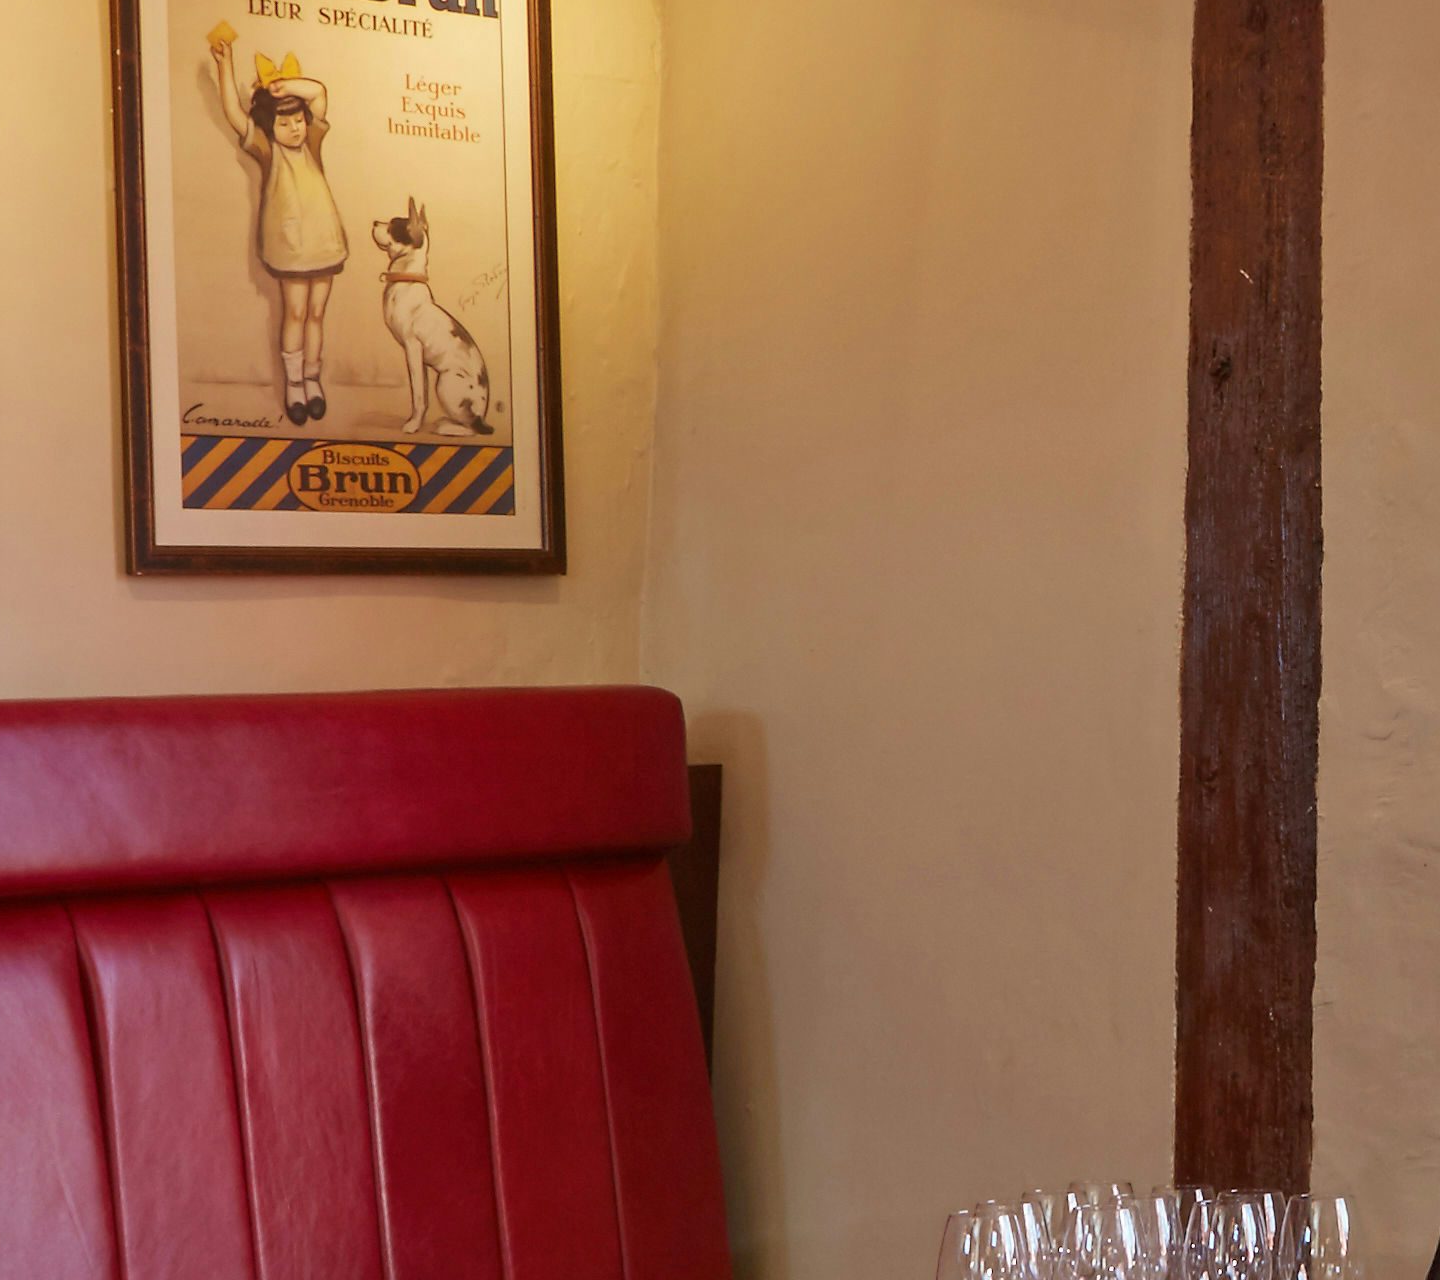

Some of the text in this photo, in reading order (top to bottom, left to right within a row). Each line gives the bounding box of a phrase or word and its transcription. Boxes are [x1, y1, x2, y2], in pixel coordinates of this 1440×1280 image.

[318, 5, 434, 39] SPÉCIALITÉ
[405, 74, 463, 100] Léger
[401, 96, 466, 120] Exquis
[387, 118, 481, 143] Inimitable
[322, 449, 390, 465] Biscuits
[297, 464, 413, 495] Brun
[318, 492, 394, 508] Grenoble
